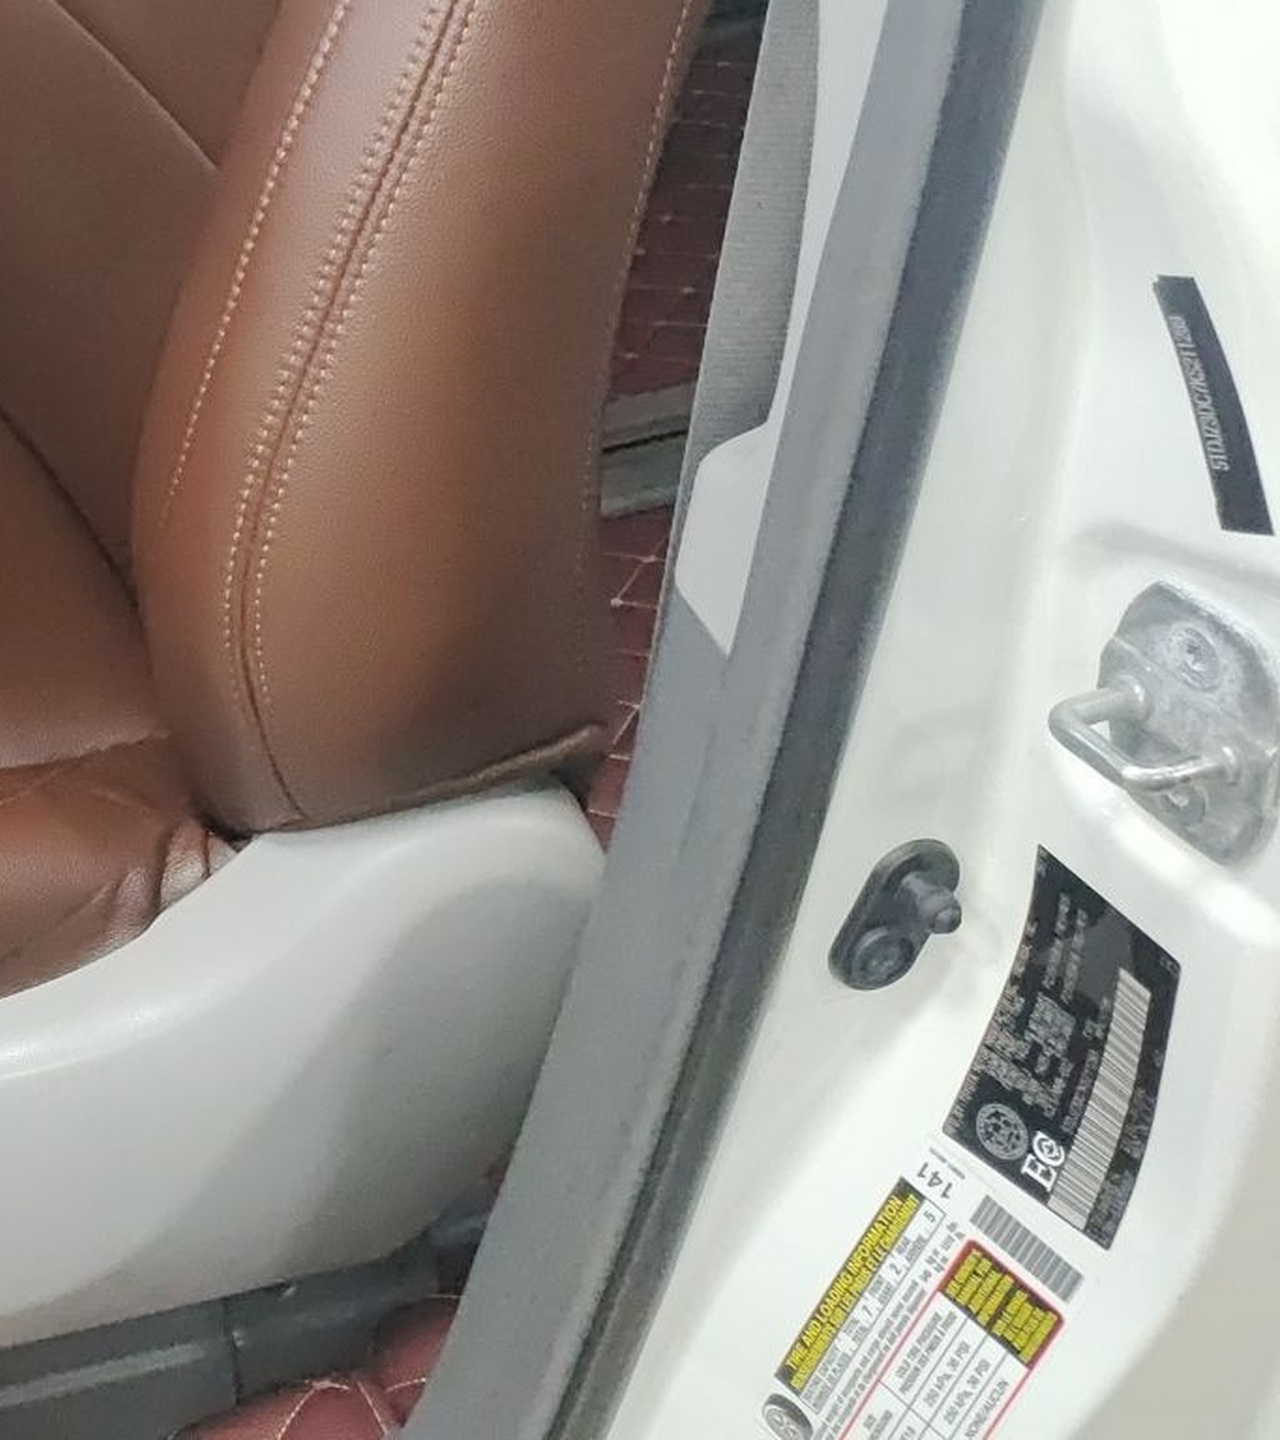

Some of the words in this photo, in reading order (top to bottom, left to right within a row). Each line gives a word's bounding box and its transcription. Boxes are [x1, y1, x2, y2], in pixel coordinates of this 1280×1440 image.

[917, 1162, 953, 1199] 141
[923, 1210, 936, 1223] 5
[888, 1262, 901, 1275] 2
[785, 1342, 808, 1371] TIRE
[800, 1318, 823, 1346] AND
[814, 1270, 853, 1323] LOADING
[845, 1194, 903, 1275] INFORMATION
